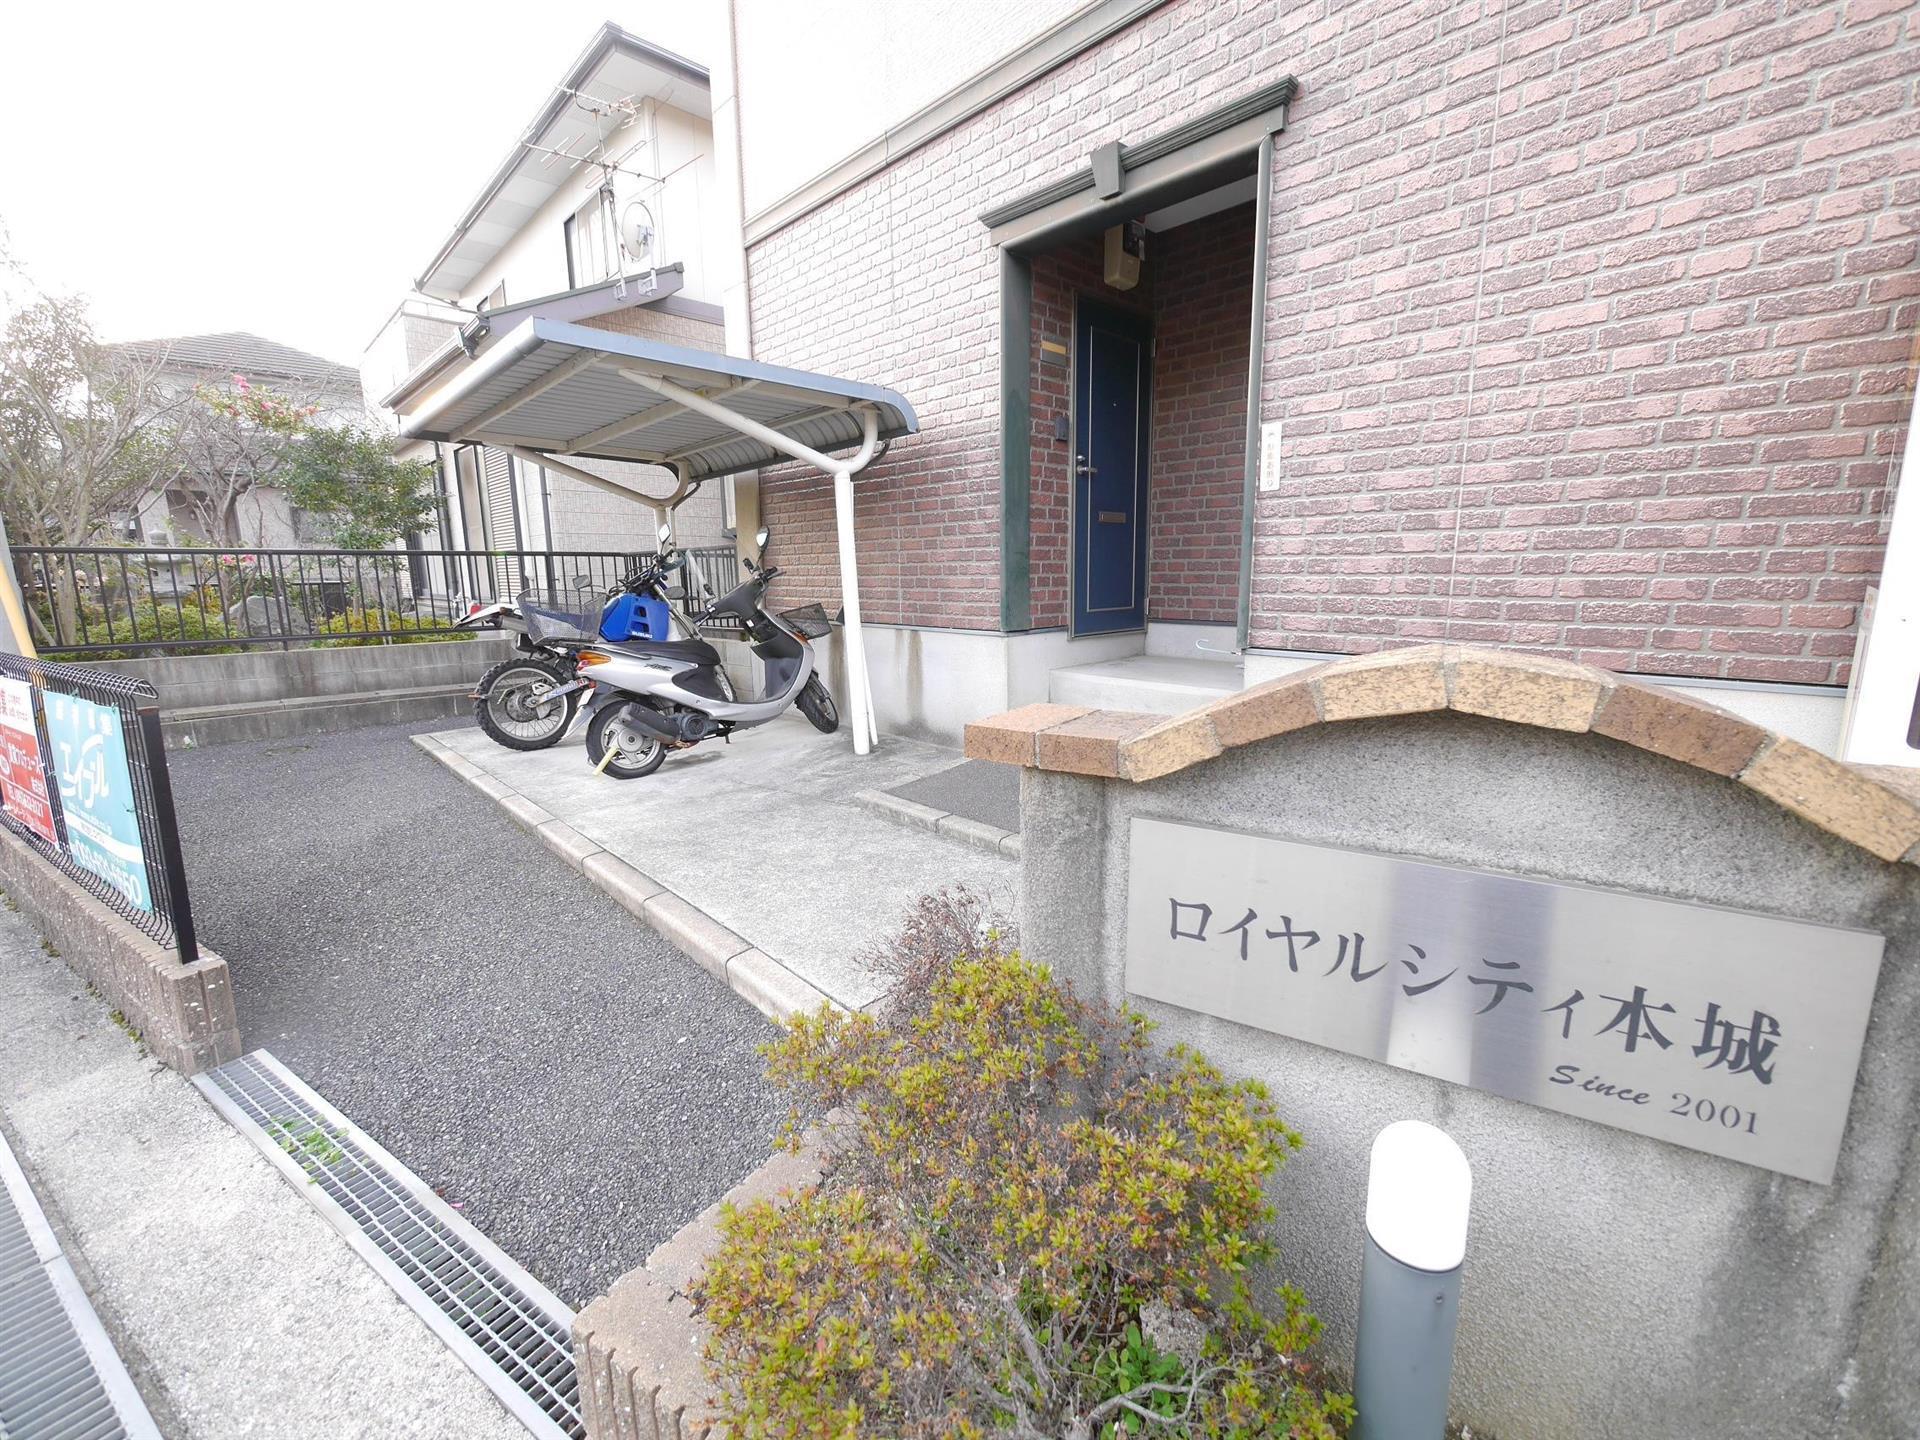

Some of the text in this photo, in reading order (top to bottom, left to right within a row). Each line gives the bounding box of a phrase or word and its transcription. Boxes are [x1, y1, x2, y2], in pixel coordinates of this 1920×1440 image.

[1168, 897, 1783, 1085] ロイヤルシティ本城
[1548, 1064, 1760, 1136] Since 2001
